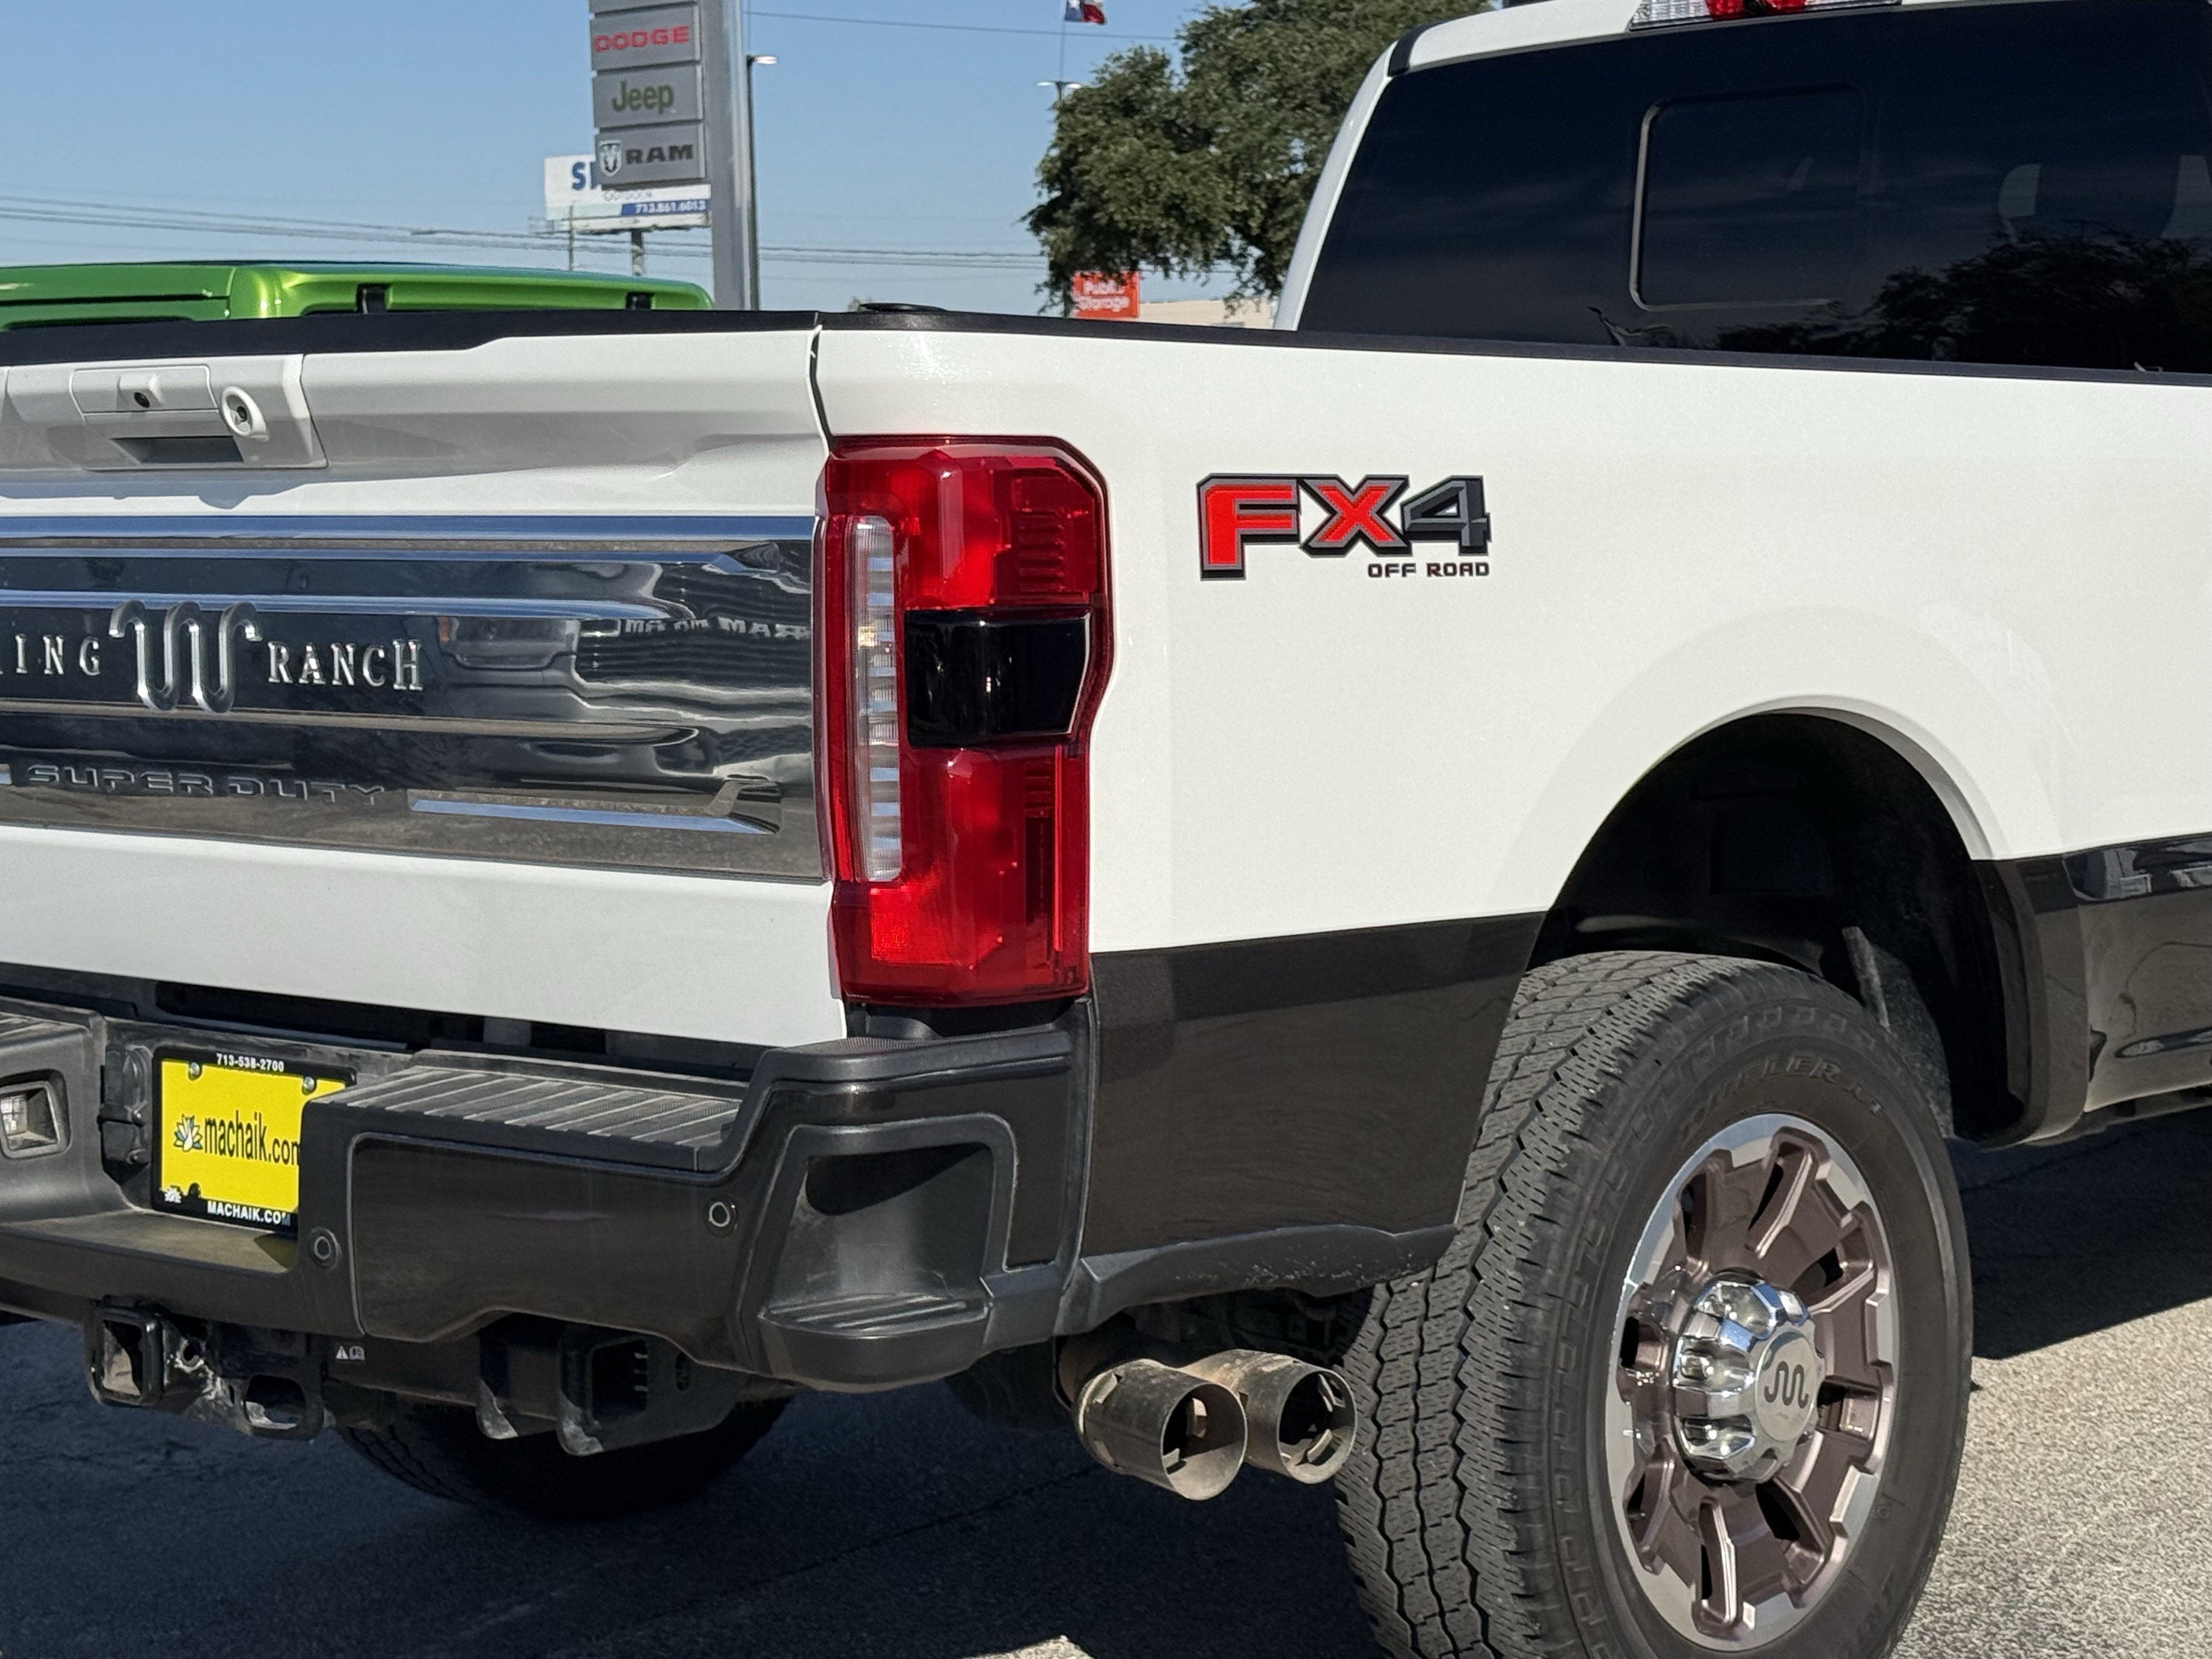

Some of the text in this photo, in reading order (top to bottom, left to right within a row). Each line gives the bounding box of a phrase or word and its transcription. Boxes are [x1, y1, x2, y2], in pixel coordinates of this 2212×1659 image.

[594, 26, 690, 53] DODGE
[611, 80, 674, 115] Jeep
[626, 143, 694, 165] RAM
[1196, 472, 1492, 581] FX4
[1368, 562, 1490, 578] OFF ROAD
[0, 634, 424, 691] ING RANCH
[27, 764, 385, 805] SUPER DUTY
[216, 1052, 285, 1073] 713-538-2700
[207, 1200, 291, 1227] MACHAIK.COM
